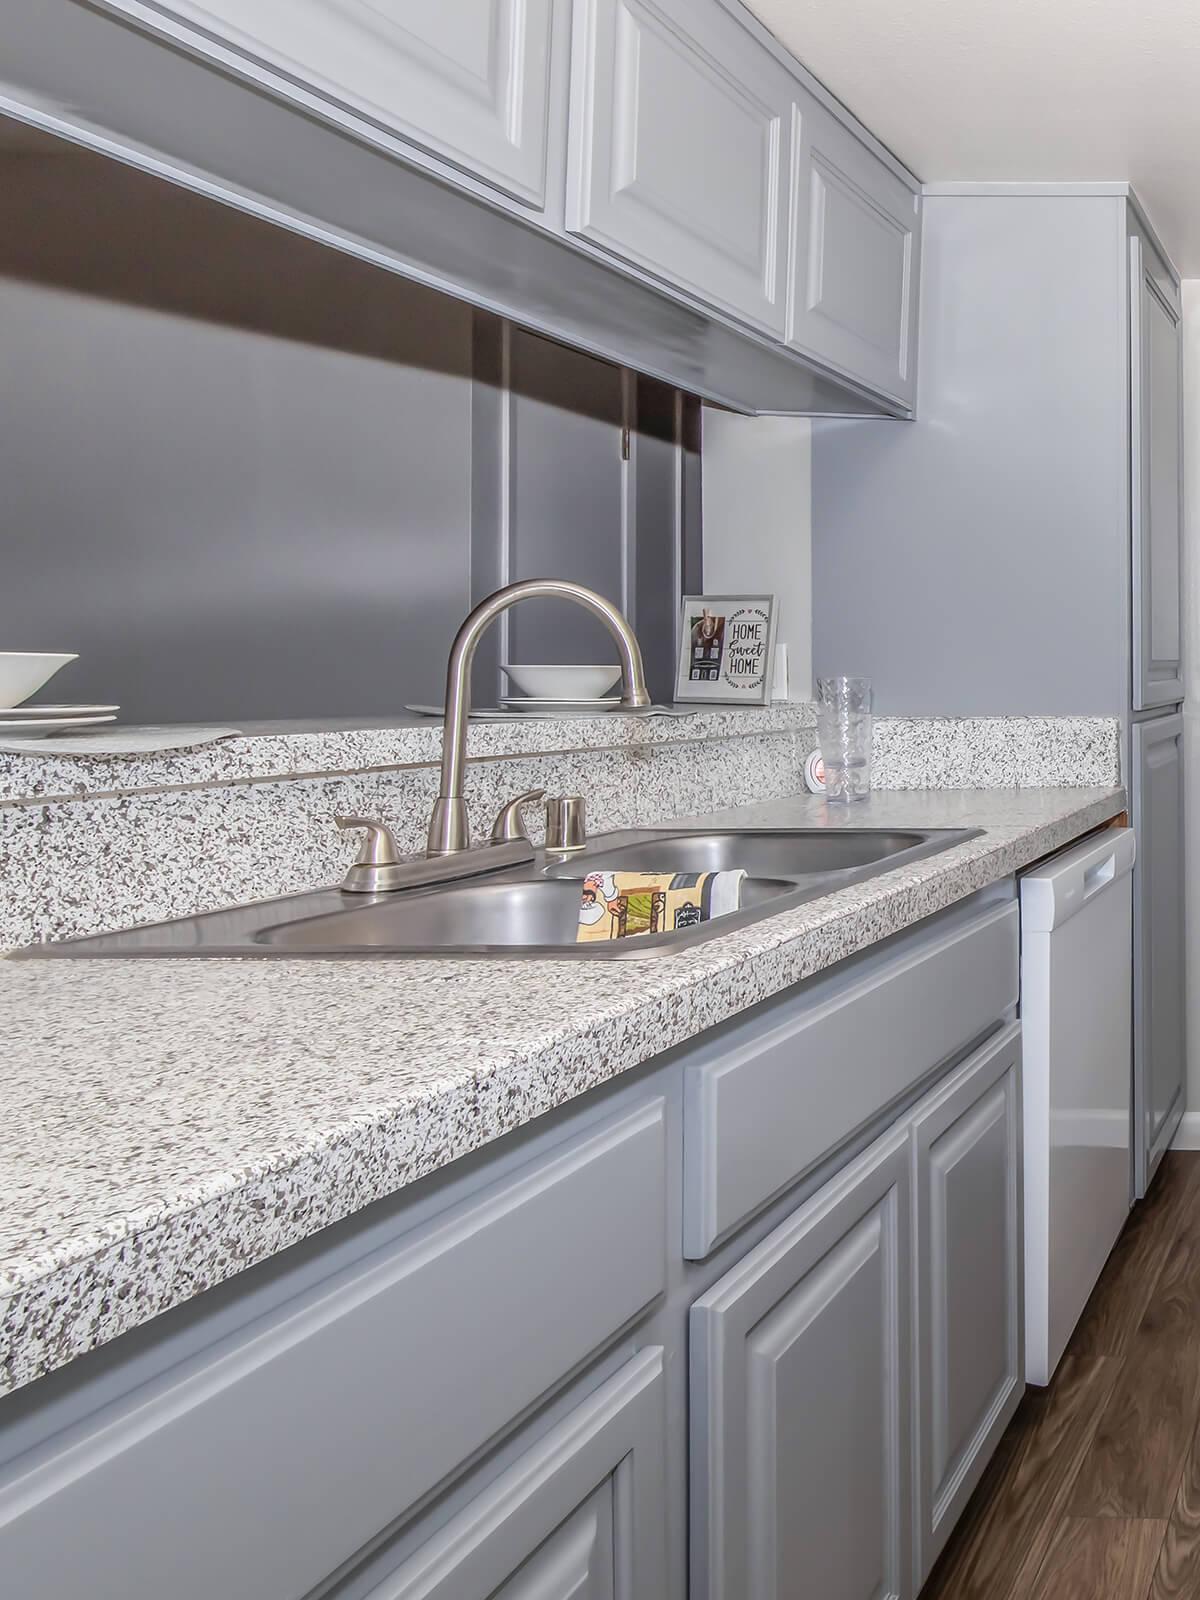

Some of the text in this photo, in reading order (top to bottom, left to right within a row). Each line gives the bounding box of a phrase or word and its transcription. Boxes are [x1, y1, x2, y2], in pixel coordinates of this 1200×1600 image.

[733, 624, 761, 639] HOME
[729, 640, 764, 658] Sweet
[730, 658, 759, 674] HOME
